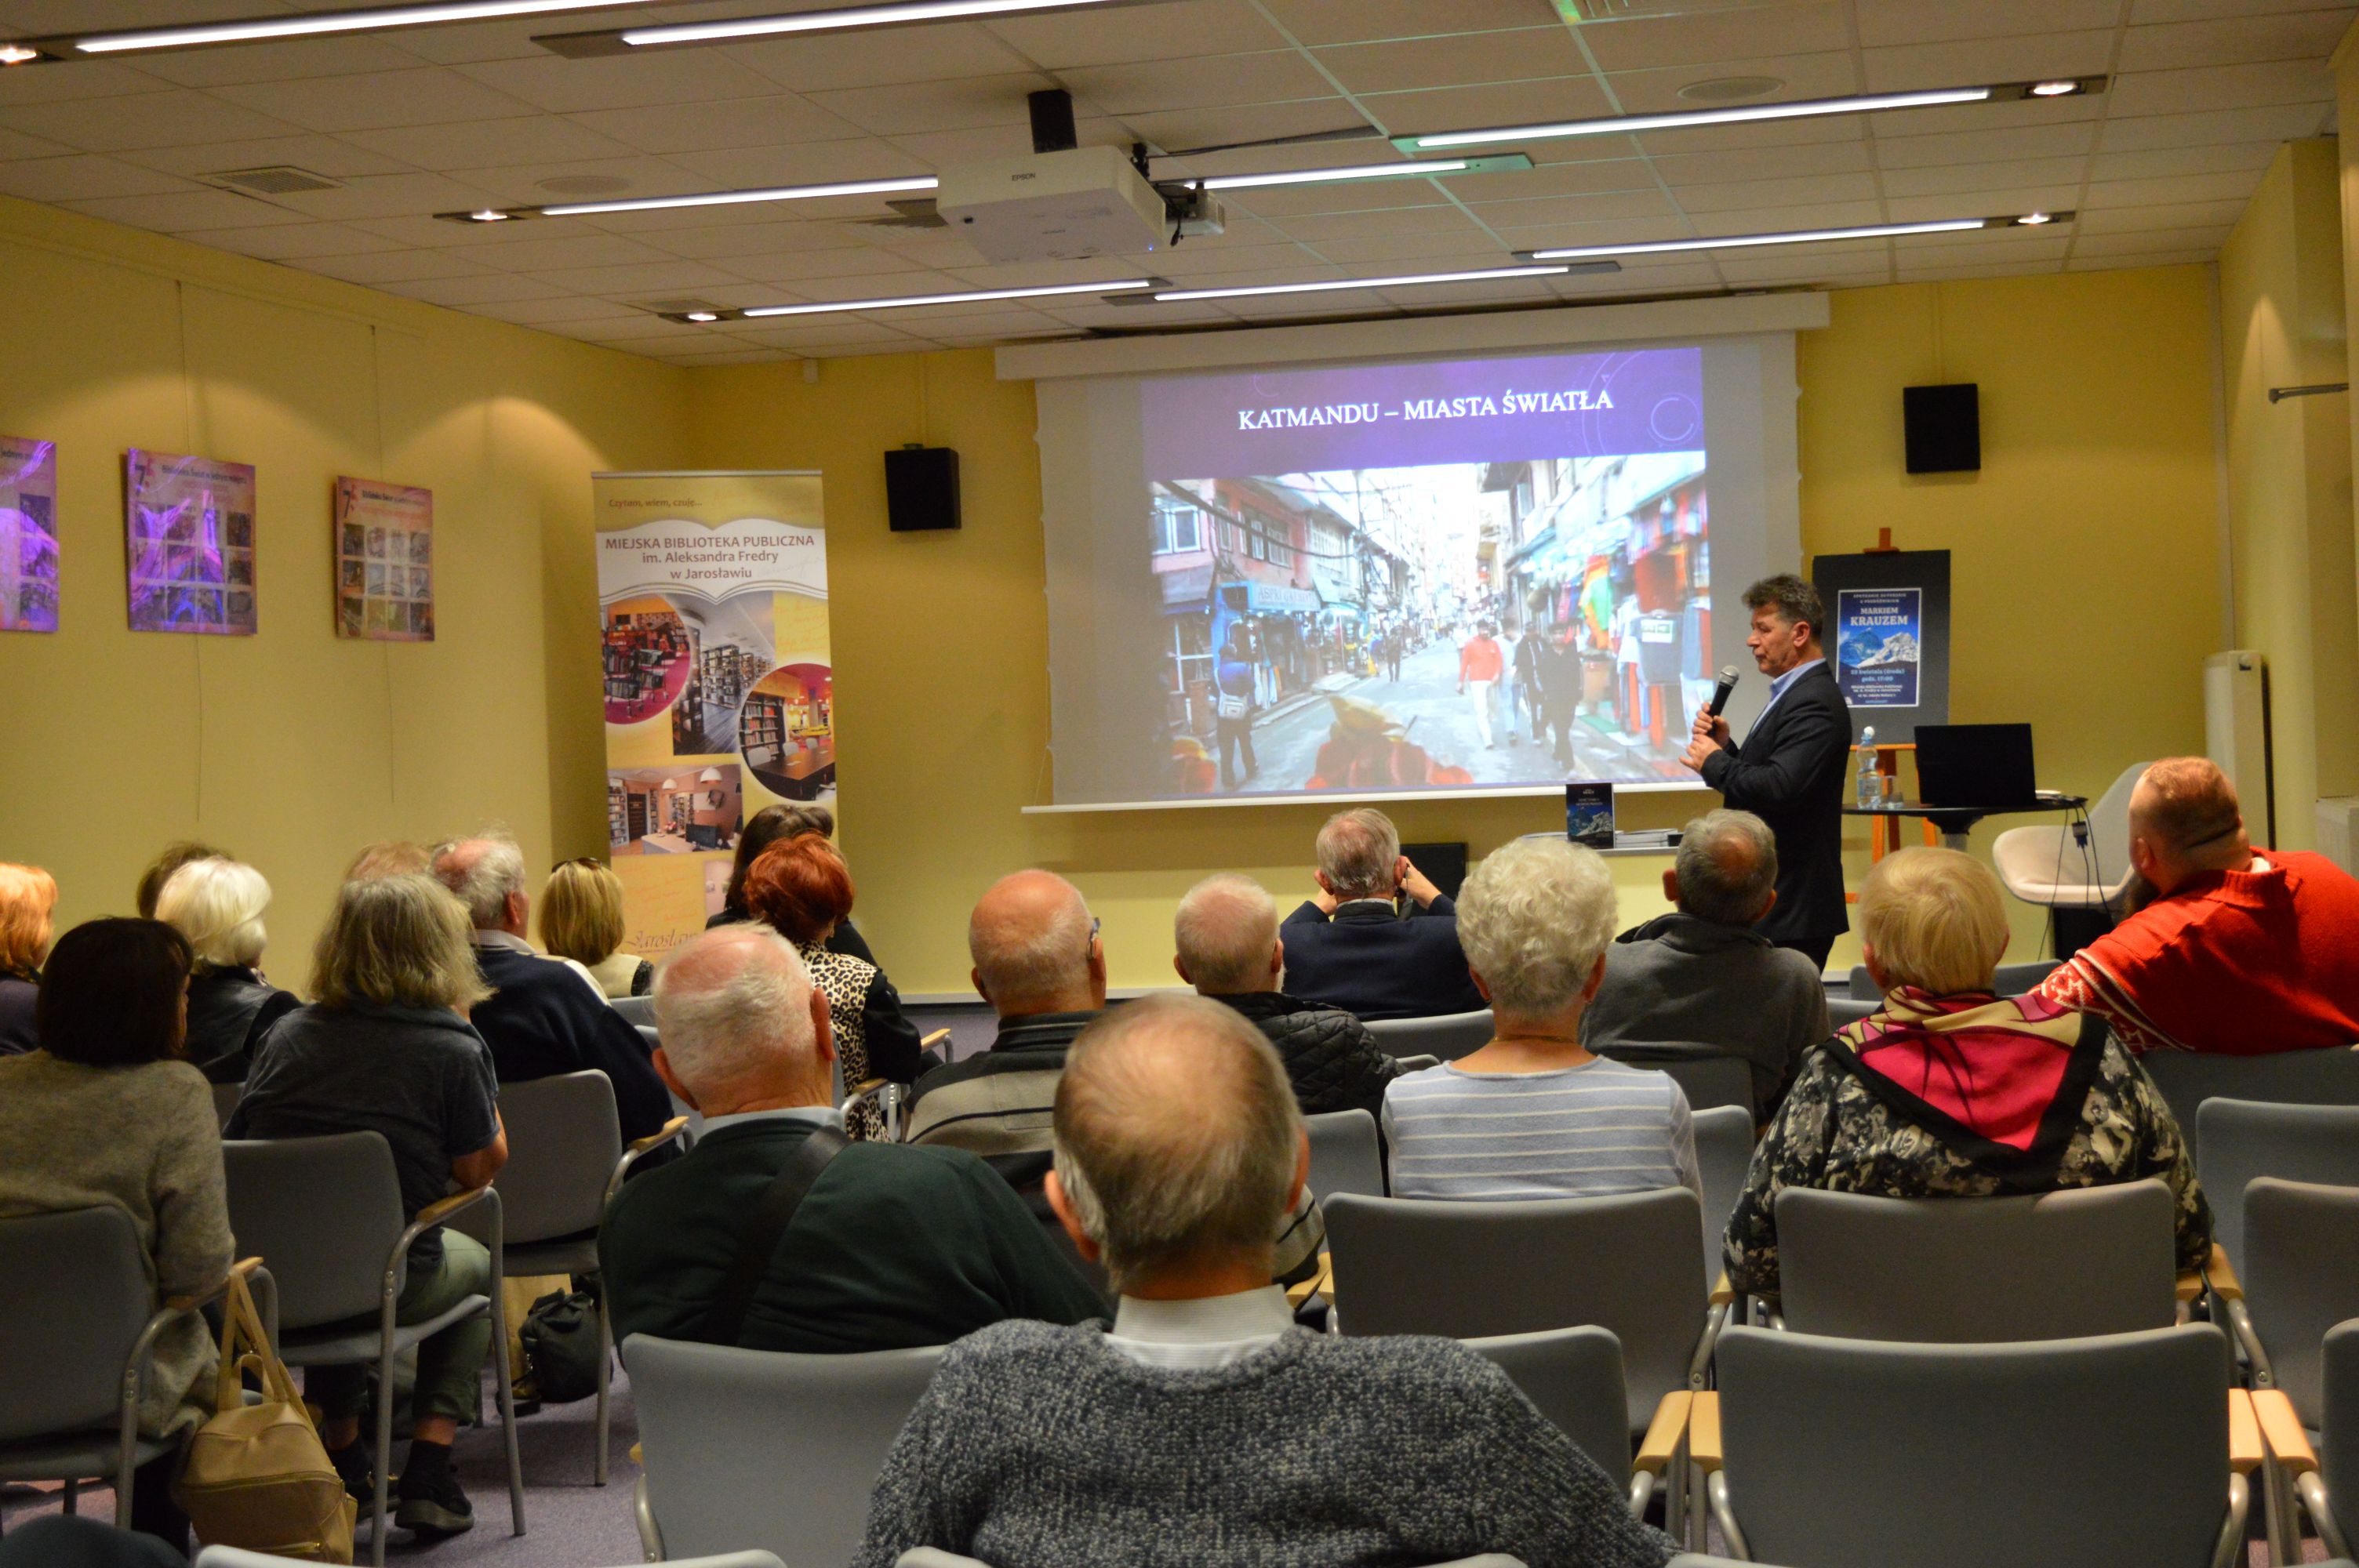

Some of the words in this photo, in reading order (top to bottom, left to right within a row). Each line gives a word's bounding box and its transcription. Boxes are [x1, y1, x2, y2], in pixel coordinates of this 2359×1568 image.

[1238, 403, 1379, 430] KATMANDU
[1404, 397, 1498, 420] MIASTA
[1503, 390, 1614, 415] ŚWIATŁA
[609, 499, 643, 509] Czytam,
[645, 498, 671, 508] wiem,
[605, 538, 661, 549] MIEJSKA
[664, 537, 740, 548] BIBLIOTEKA
[743, 535, 815, 547] PUBLICZNA
[642, 553, 662, 563] im.
[665, 551, 735, 563] Aleksandra
[738, 550, 778, 564] Fredry
[670, 571, 682, 579] w
[685, 568, 752, 579] Jarosławiu
[1850, 615, 1908, 626] KRAUZEM
